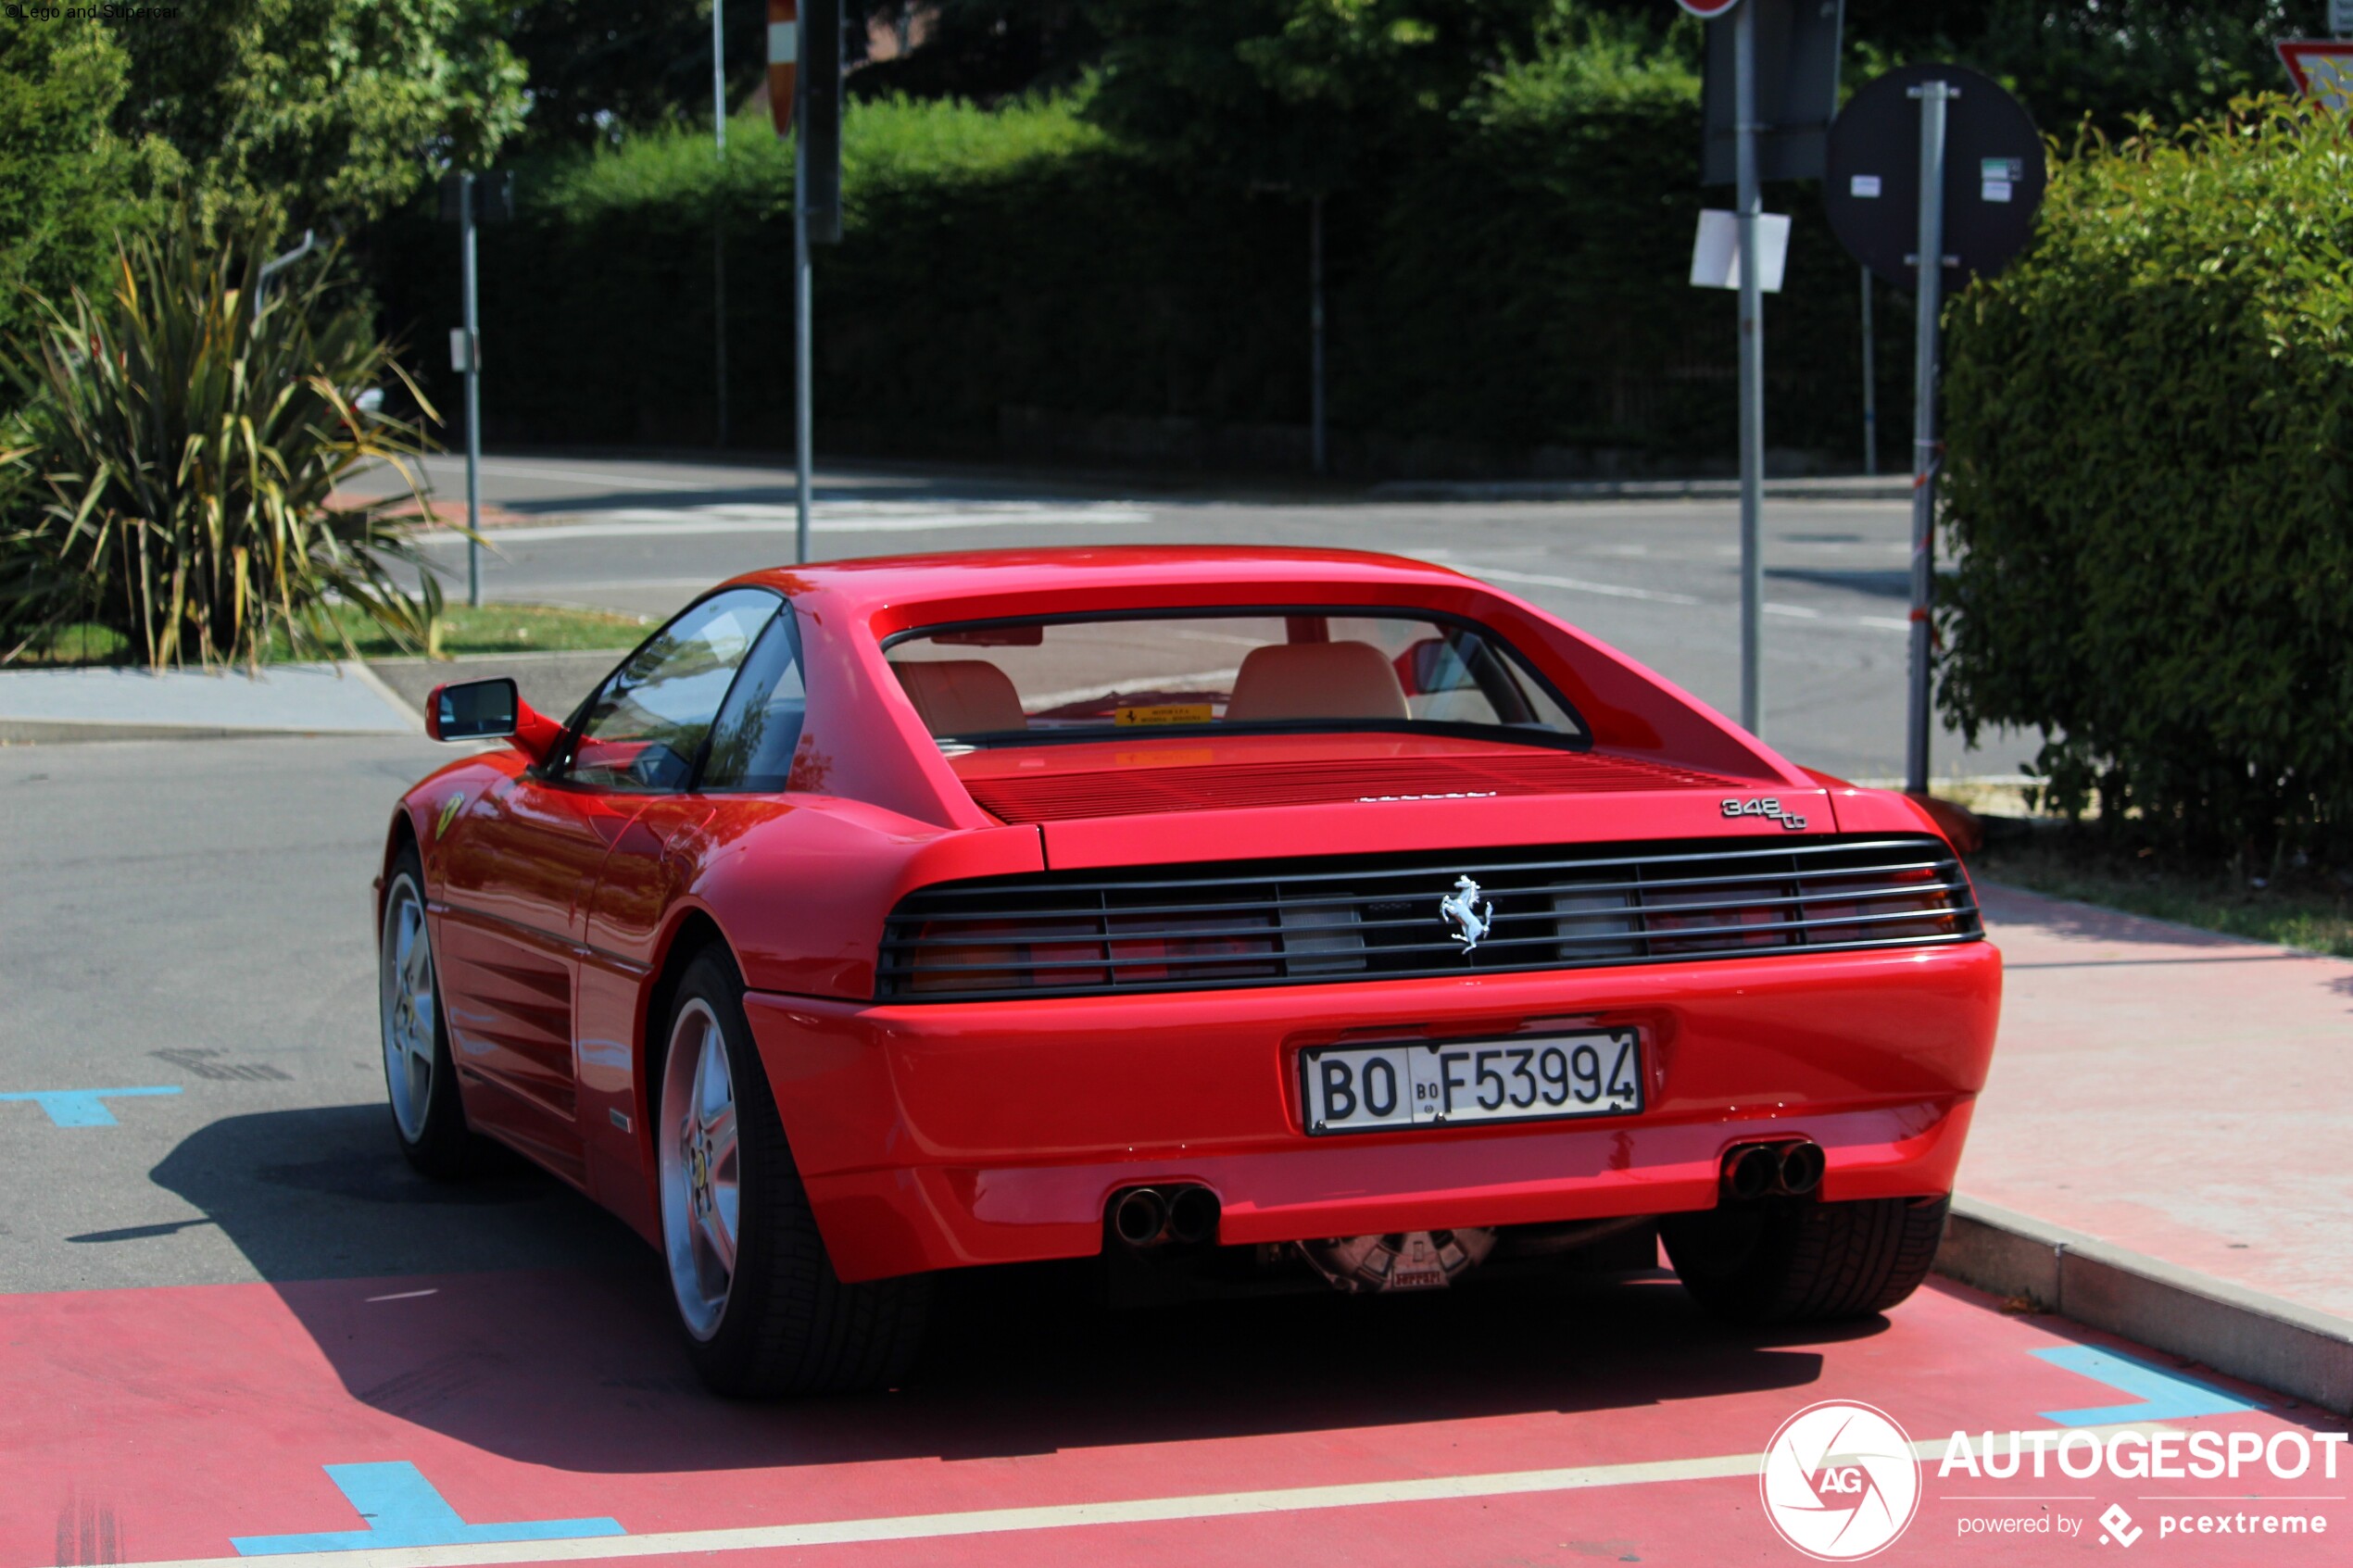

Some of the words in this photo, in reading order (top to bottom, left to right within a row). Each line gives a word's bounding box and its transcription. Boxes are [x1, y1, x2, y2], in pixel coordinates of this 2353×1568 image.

[1720, 797, 1780, 818] 348
[1320, 1057, 1397, 1121] BO
[1416, 1083, 1439, 1099] BO
[1440, 1043, 1635, 1114] F53994
